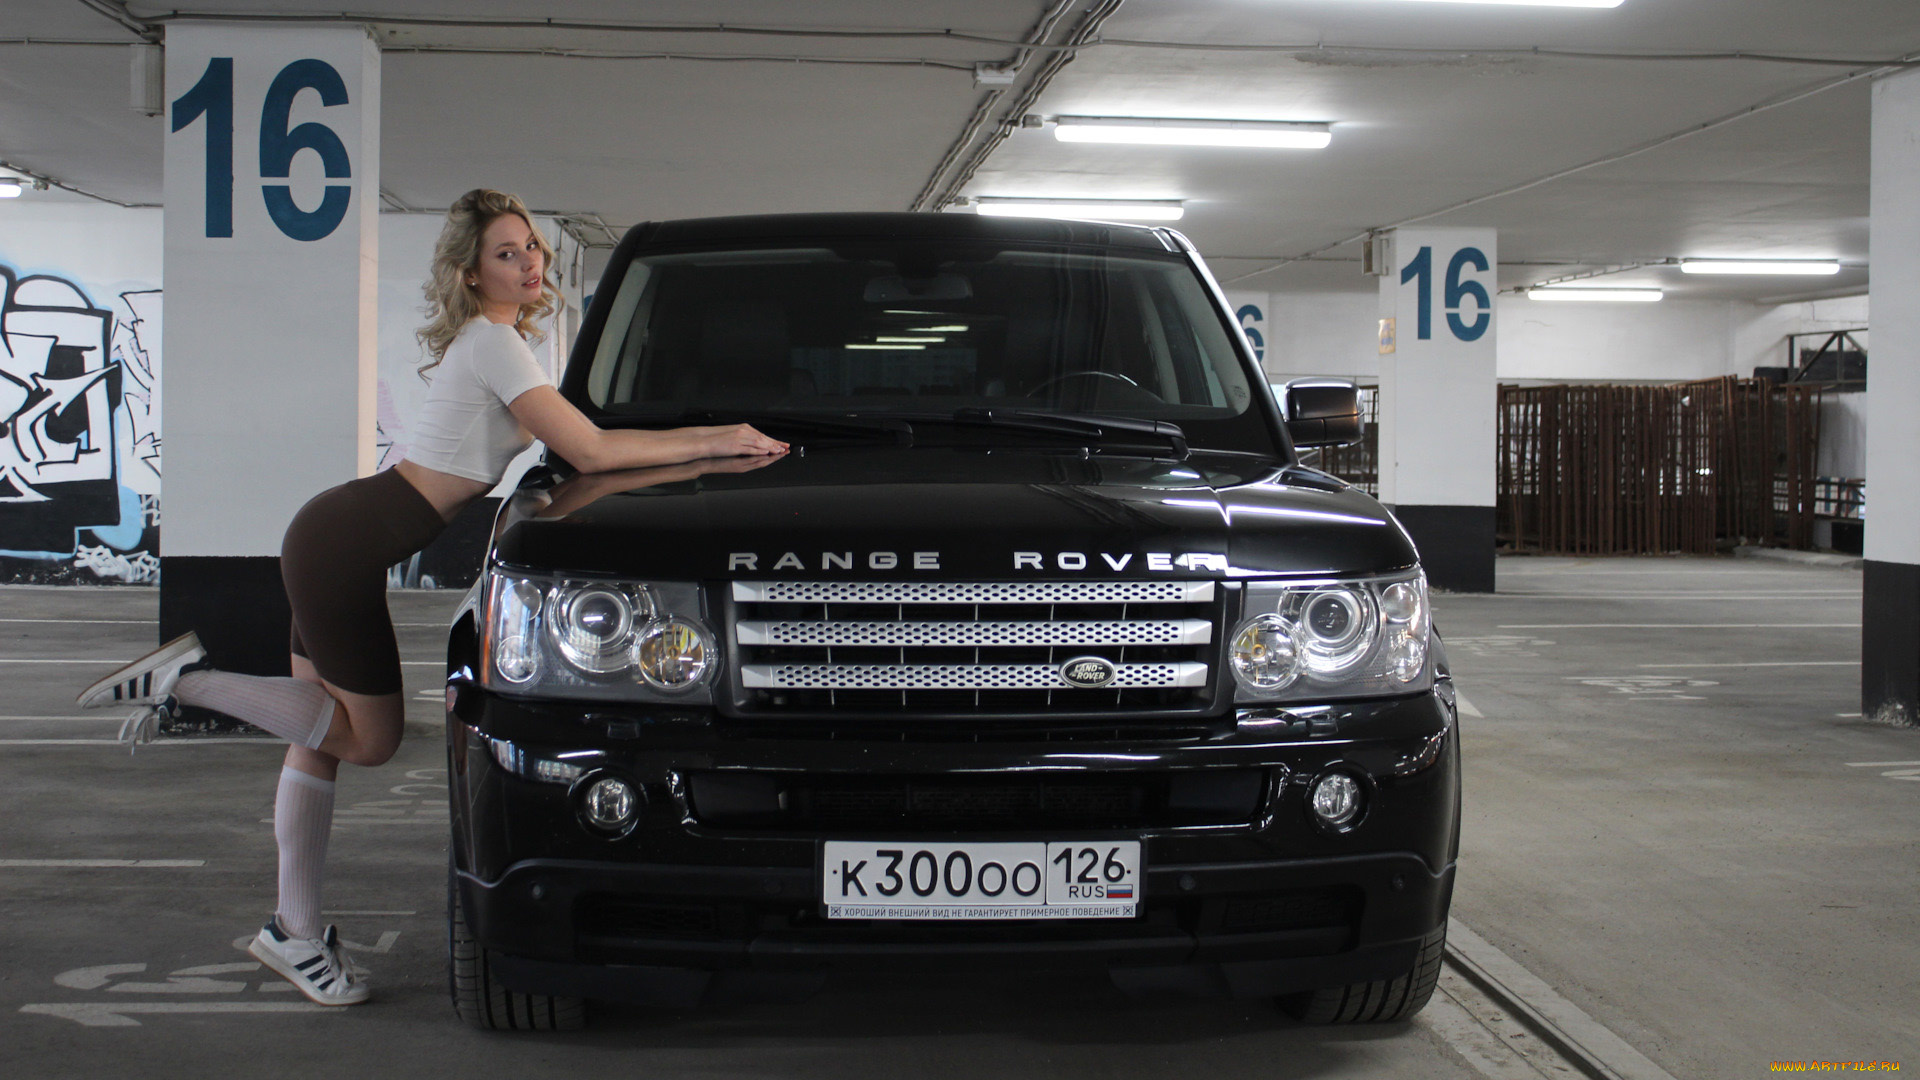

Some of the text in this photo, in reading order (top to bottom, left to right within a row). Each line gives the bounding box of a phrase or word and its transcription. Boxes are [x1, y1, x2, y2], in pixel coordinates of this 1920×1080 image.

[171, 57, 352, 242] 16
[1400, 246, 1491, 342] 16
[1236, 304, 1264, 364] 6
[728, 551, 1219, 572] RANGE ROVER
[1053, 847, 1126, 884] 126
[1069, 885, 1105, 899] RUS
[844, 905, 1120, 918] ХОРОШИЙ ВНЕШНИЙ ВИД НЕ ГАРАНТИРУЕТ ПРИМЕРНОЕ ПОВЕДЕНИЕ
